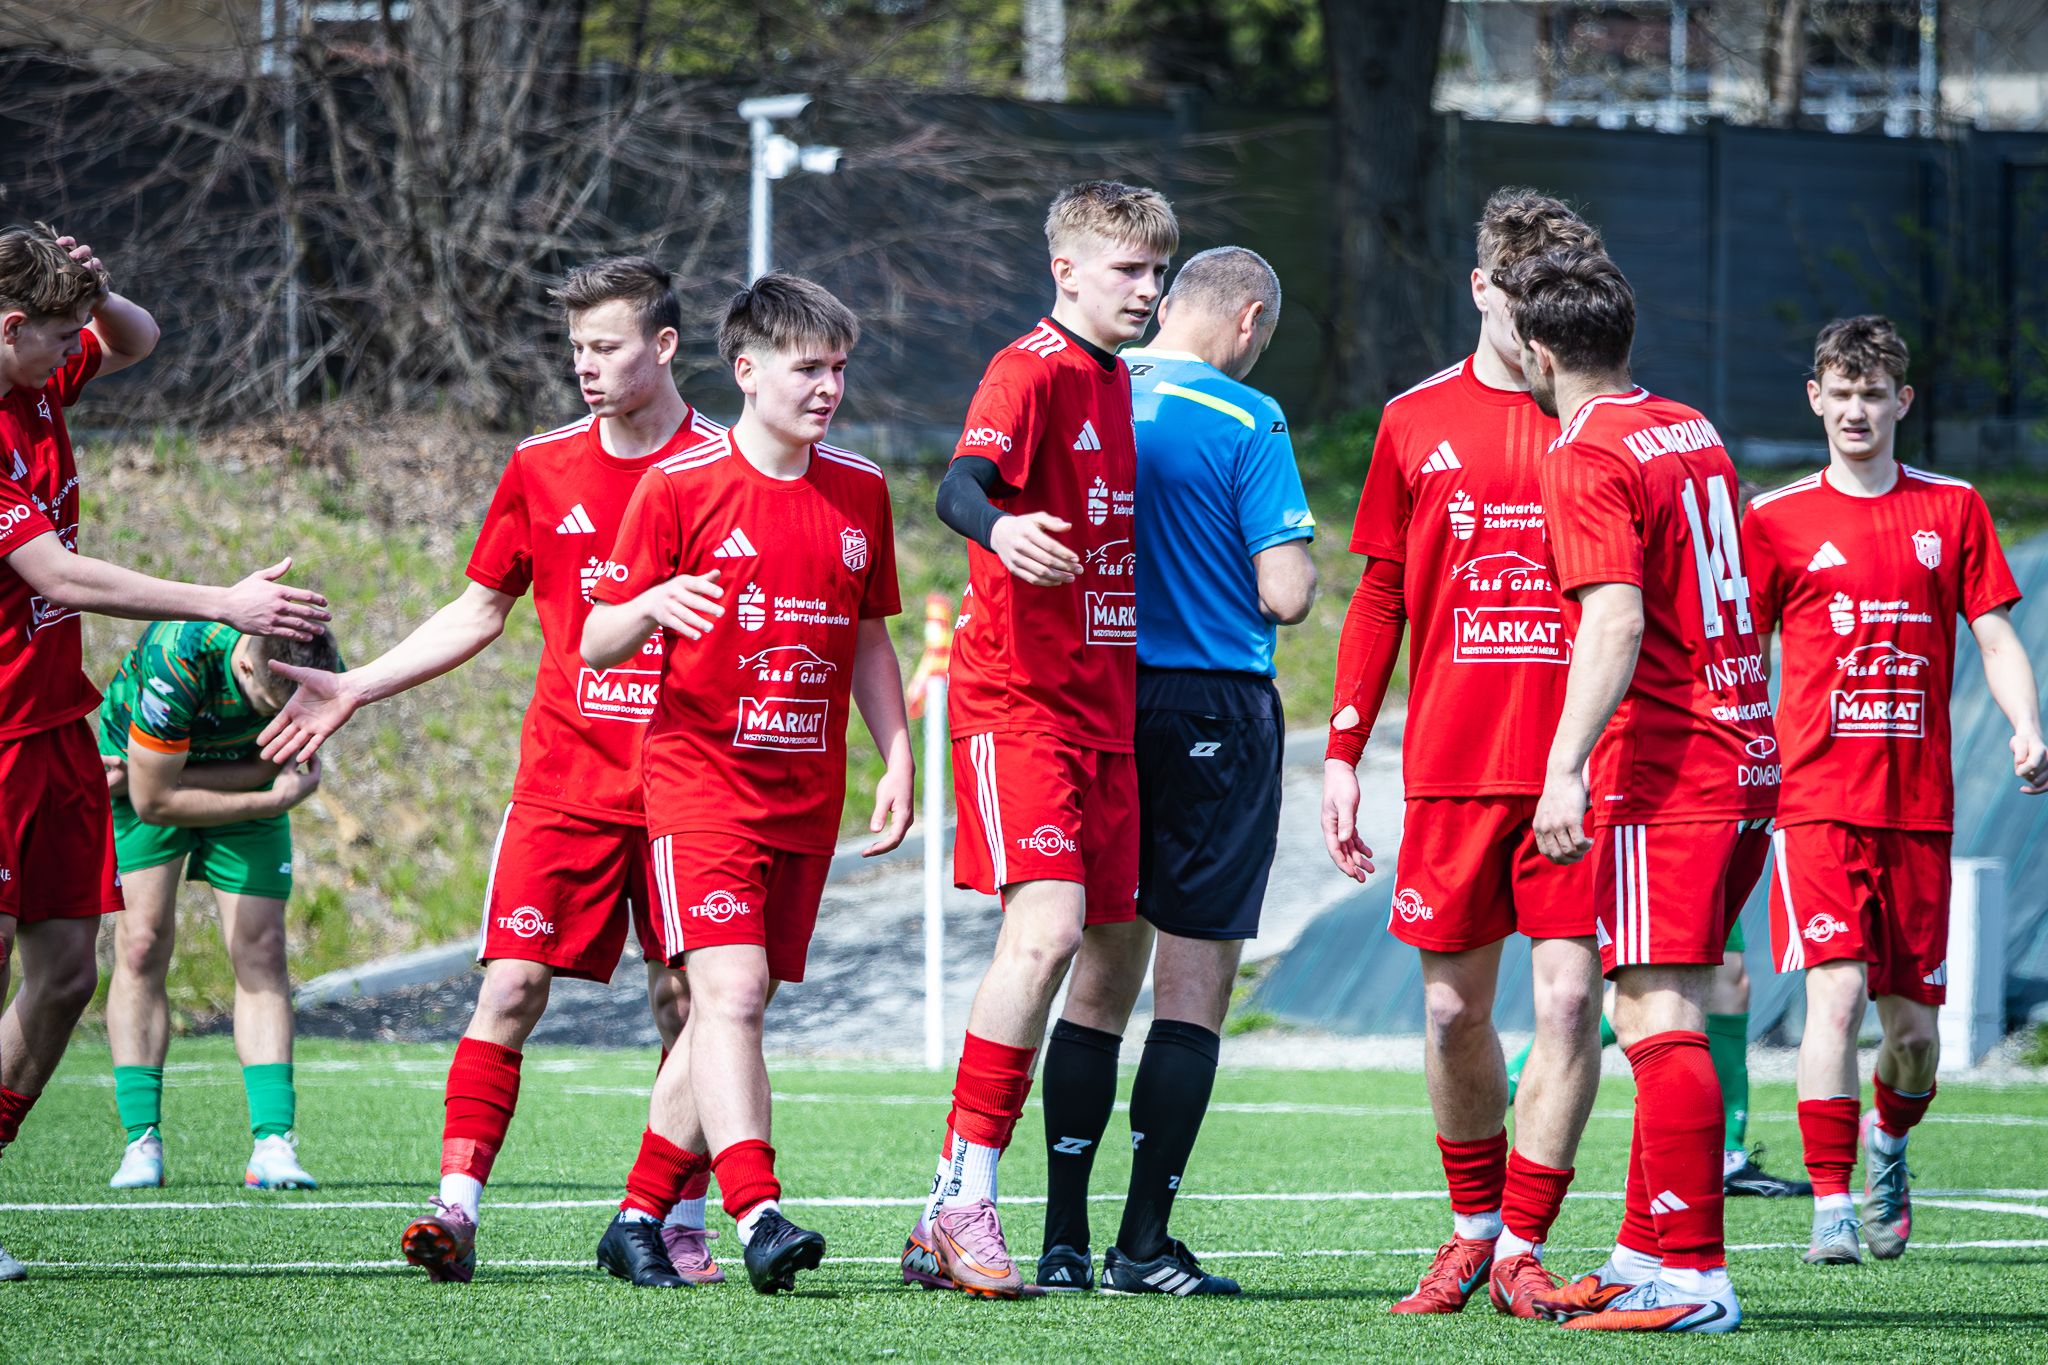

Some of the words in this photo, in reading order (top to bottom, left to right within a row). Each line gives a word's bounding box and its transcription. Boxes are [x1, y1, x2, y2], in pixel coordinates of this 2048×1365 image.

[1484, 502, 1543, 515] Kalwaria
[1483, 516, 1545, 531] Zebrzydo
[1681, 474, 1751, 639] 14
[774, 597, 827, 611] Kalwaria
[774, 610, 850, 626] Zebrzydowska
[1093, 605, 1137, 627] MARK
[1462, 620, 1562, 644] MARKAT
[800, 671, 827, 684] CARS
[747, 709, 822, 733] MARKAT
[1017, 836, 1077, 853] TESONE
[688, 901, 751, 918] TESONE
[496, 916, 555, 935] TESONE
